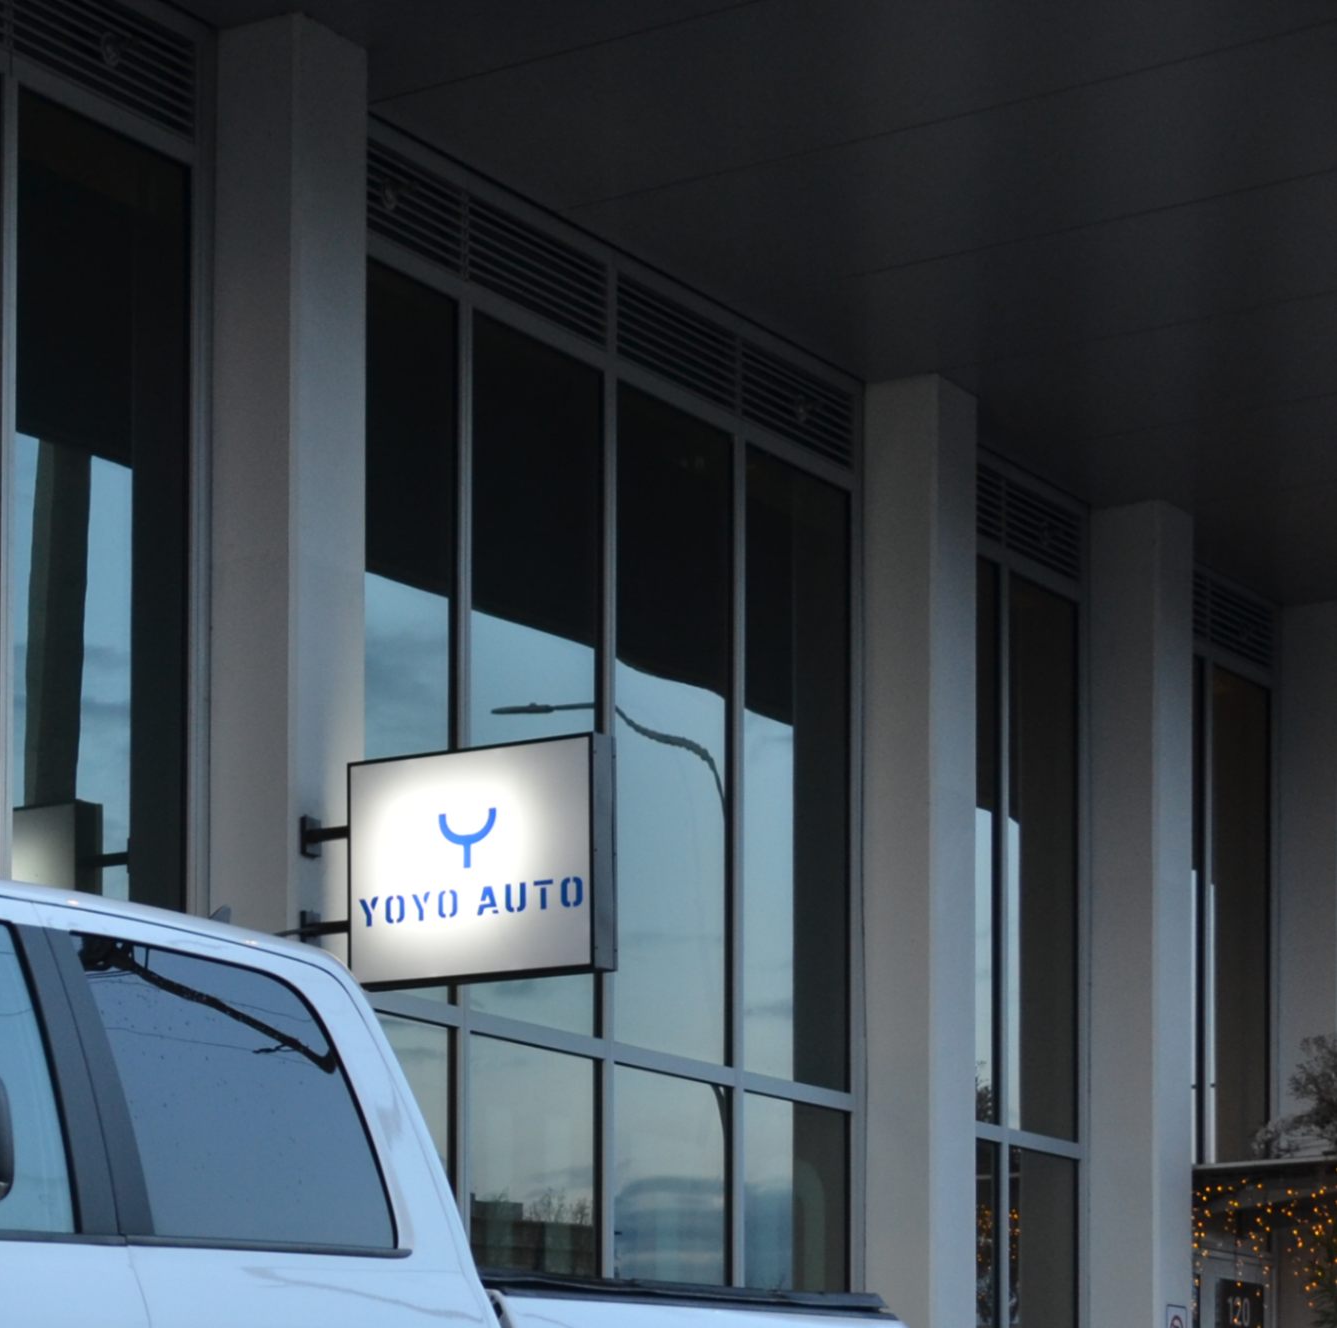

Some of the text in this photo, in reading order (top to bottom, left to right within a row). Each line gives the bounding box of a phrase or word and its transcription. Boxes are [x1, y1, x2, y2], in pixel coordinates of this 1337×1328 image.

[359, 876, 584, 927] YOYO AUTO
[1227, 1296, 1250, 1327] 120
